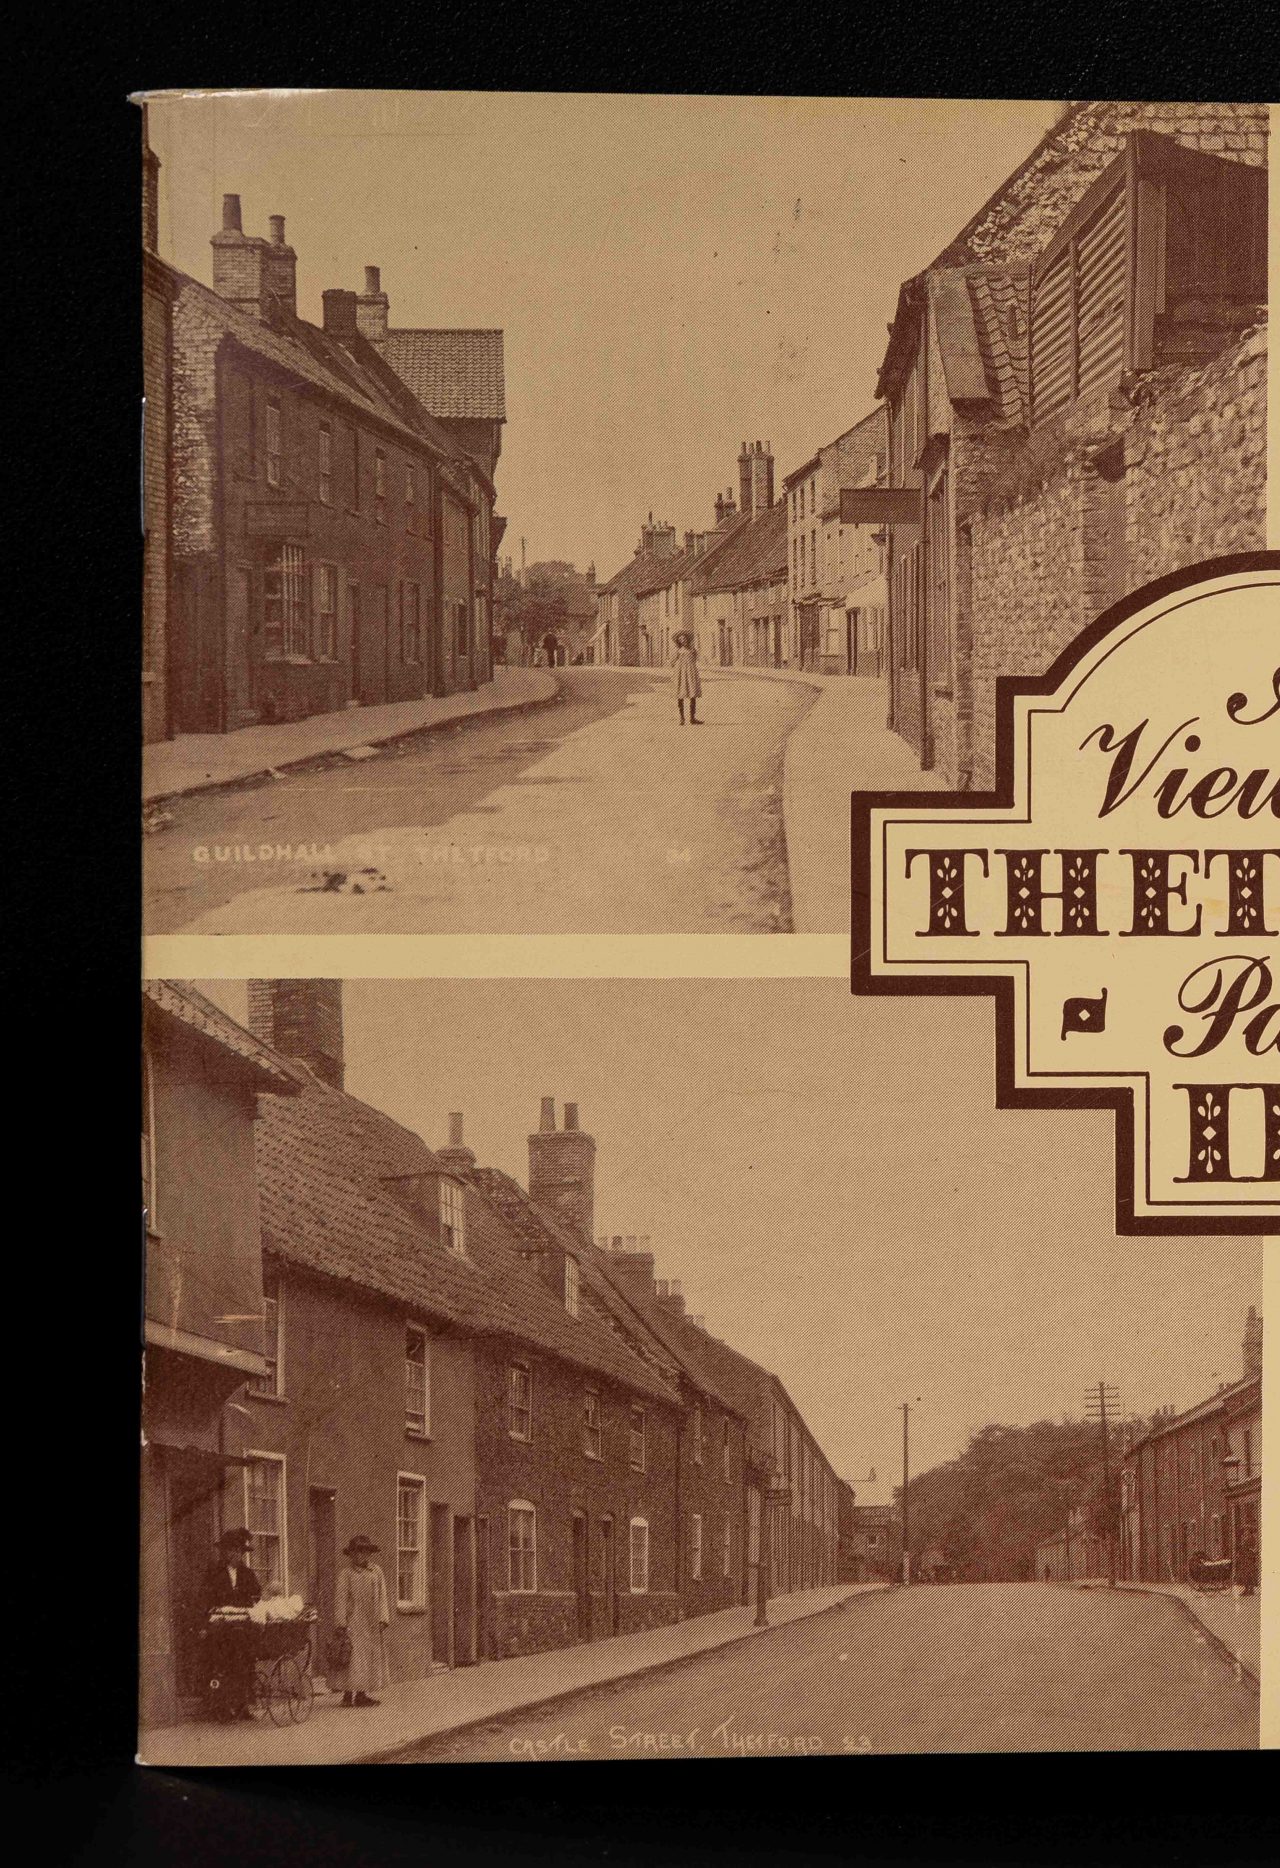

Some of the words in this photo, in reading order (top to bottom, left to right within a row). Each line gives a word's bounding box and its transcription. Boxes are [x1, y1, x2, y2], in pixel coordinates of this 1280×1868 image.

[191, 842, 337, 864] GUILDHALL
[507, 1732, 592, 1760] CASTLE
[711, 1711, 824, 1757] THETFORD
